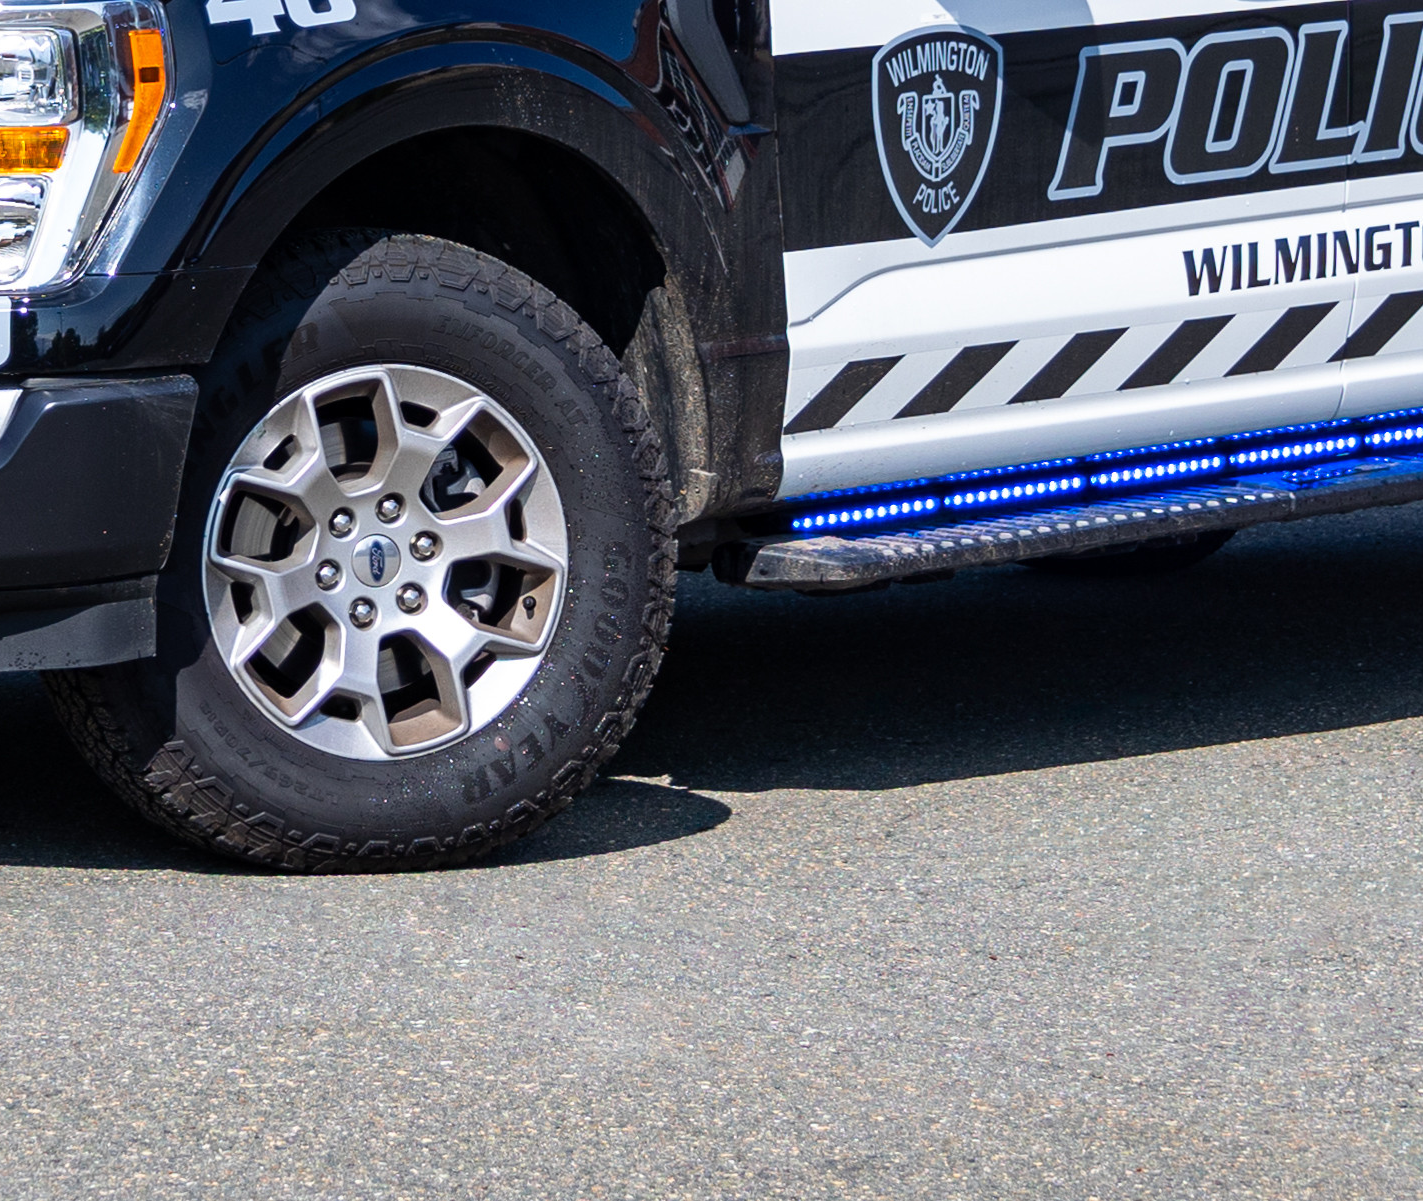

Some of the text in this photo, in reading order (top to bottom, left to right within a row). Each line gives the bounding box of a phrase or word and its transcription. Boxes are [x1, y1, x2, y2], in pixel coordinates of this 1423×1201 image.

[885, 41, 990, 87] WILMINGTON
[912, 181, 960, 214] POLICE
[433, 315, 557, 393] ENFORCER
